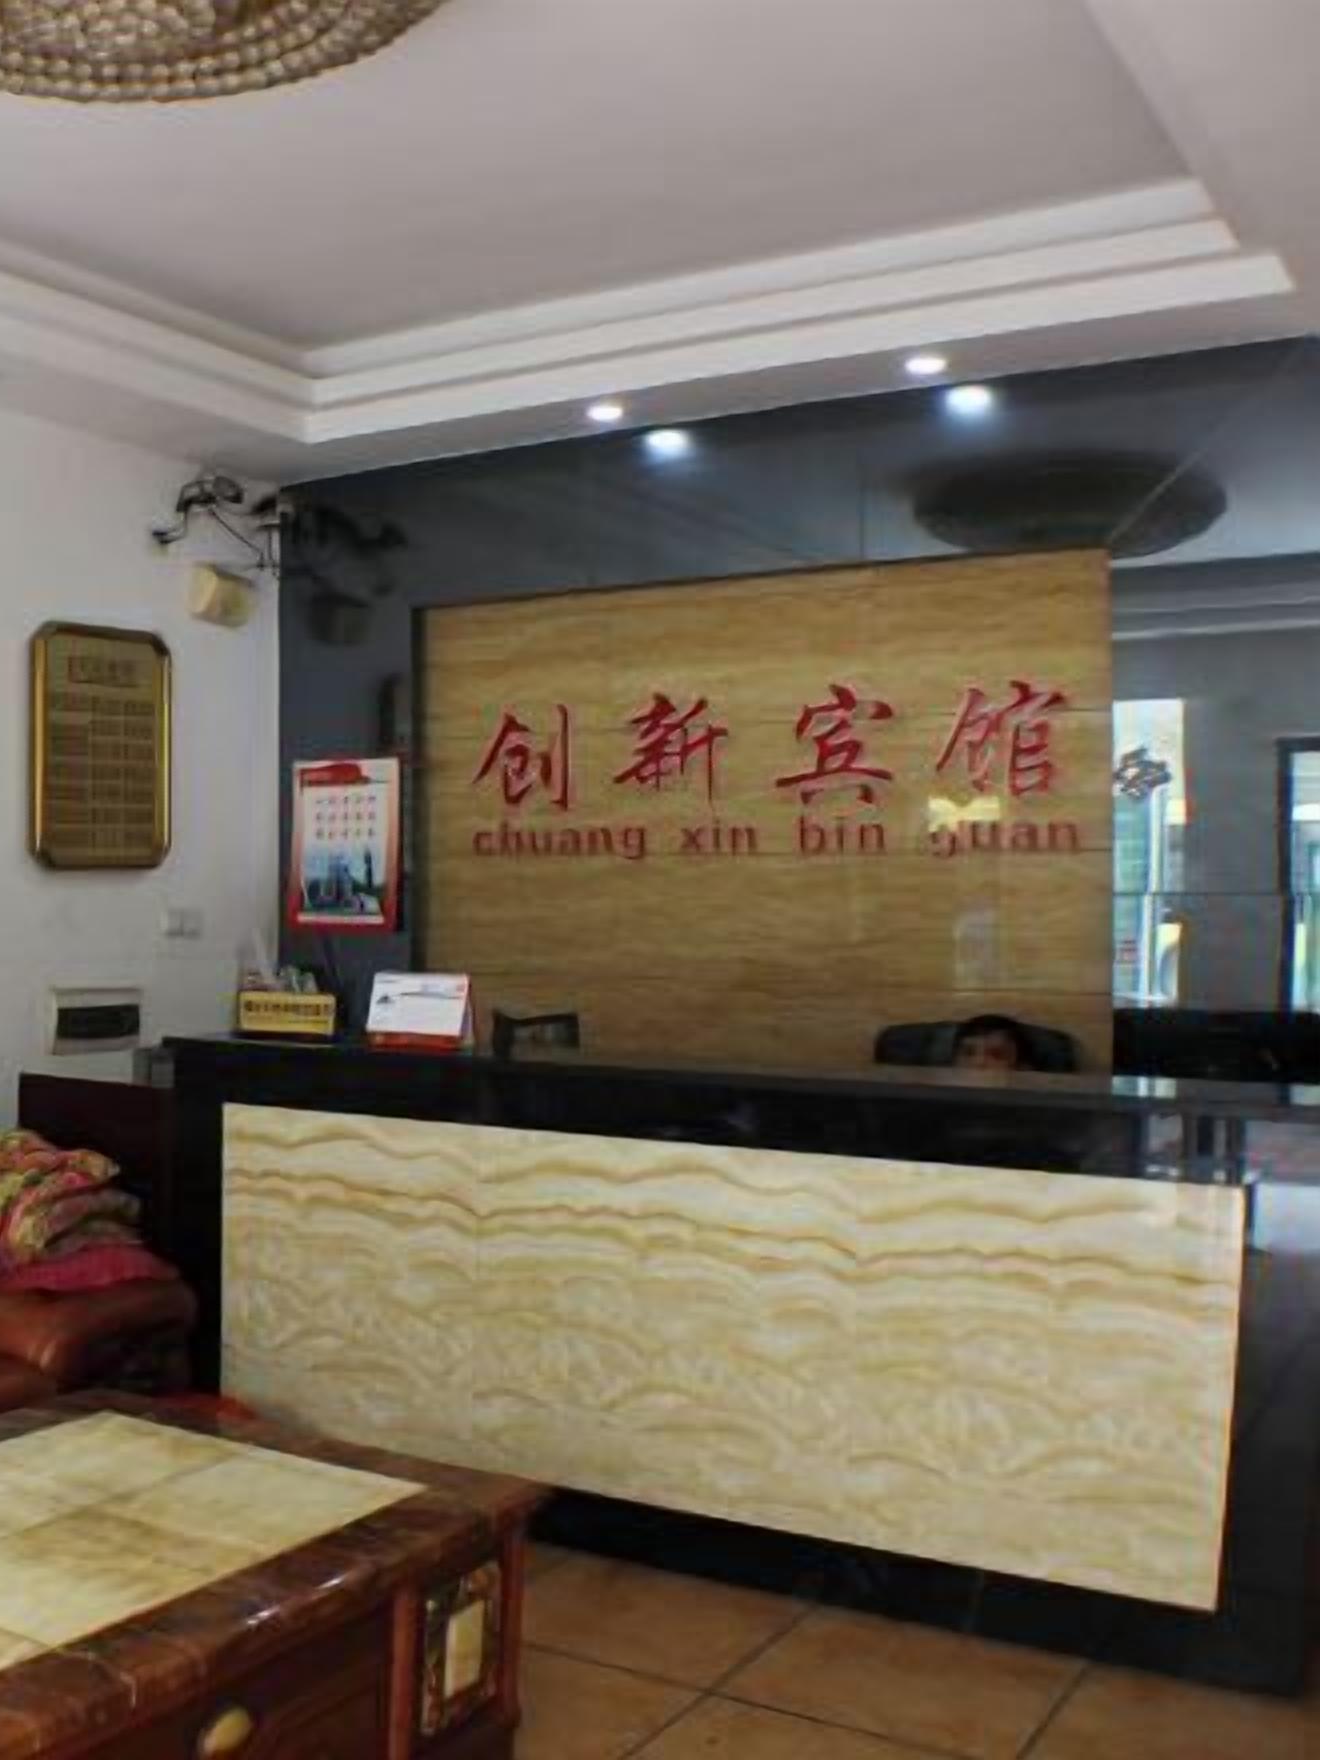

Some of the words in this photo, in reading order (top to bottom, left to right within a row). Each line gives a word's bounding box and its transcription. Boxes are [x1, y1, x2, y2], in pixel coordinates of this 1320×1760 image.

[472, 679, 1066, 812] 创新宾馆
[472, 820, 647, 860] chuang
[680, 819, 758, 856] xin
[798, 815, 886, 856] bin
